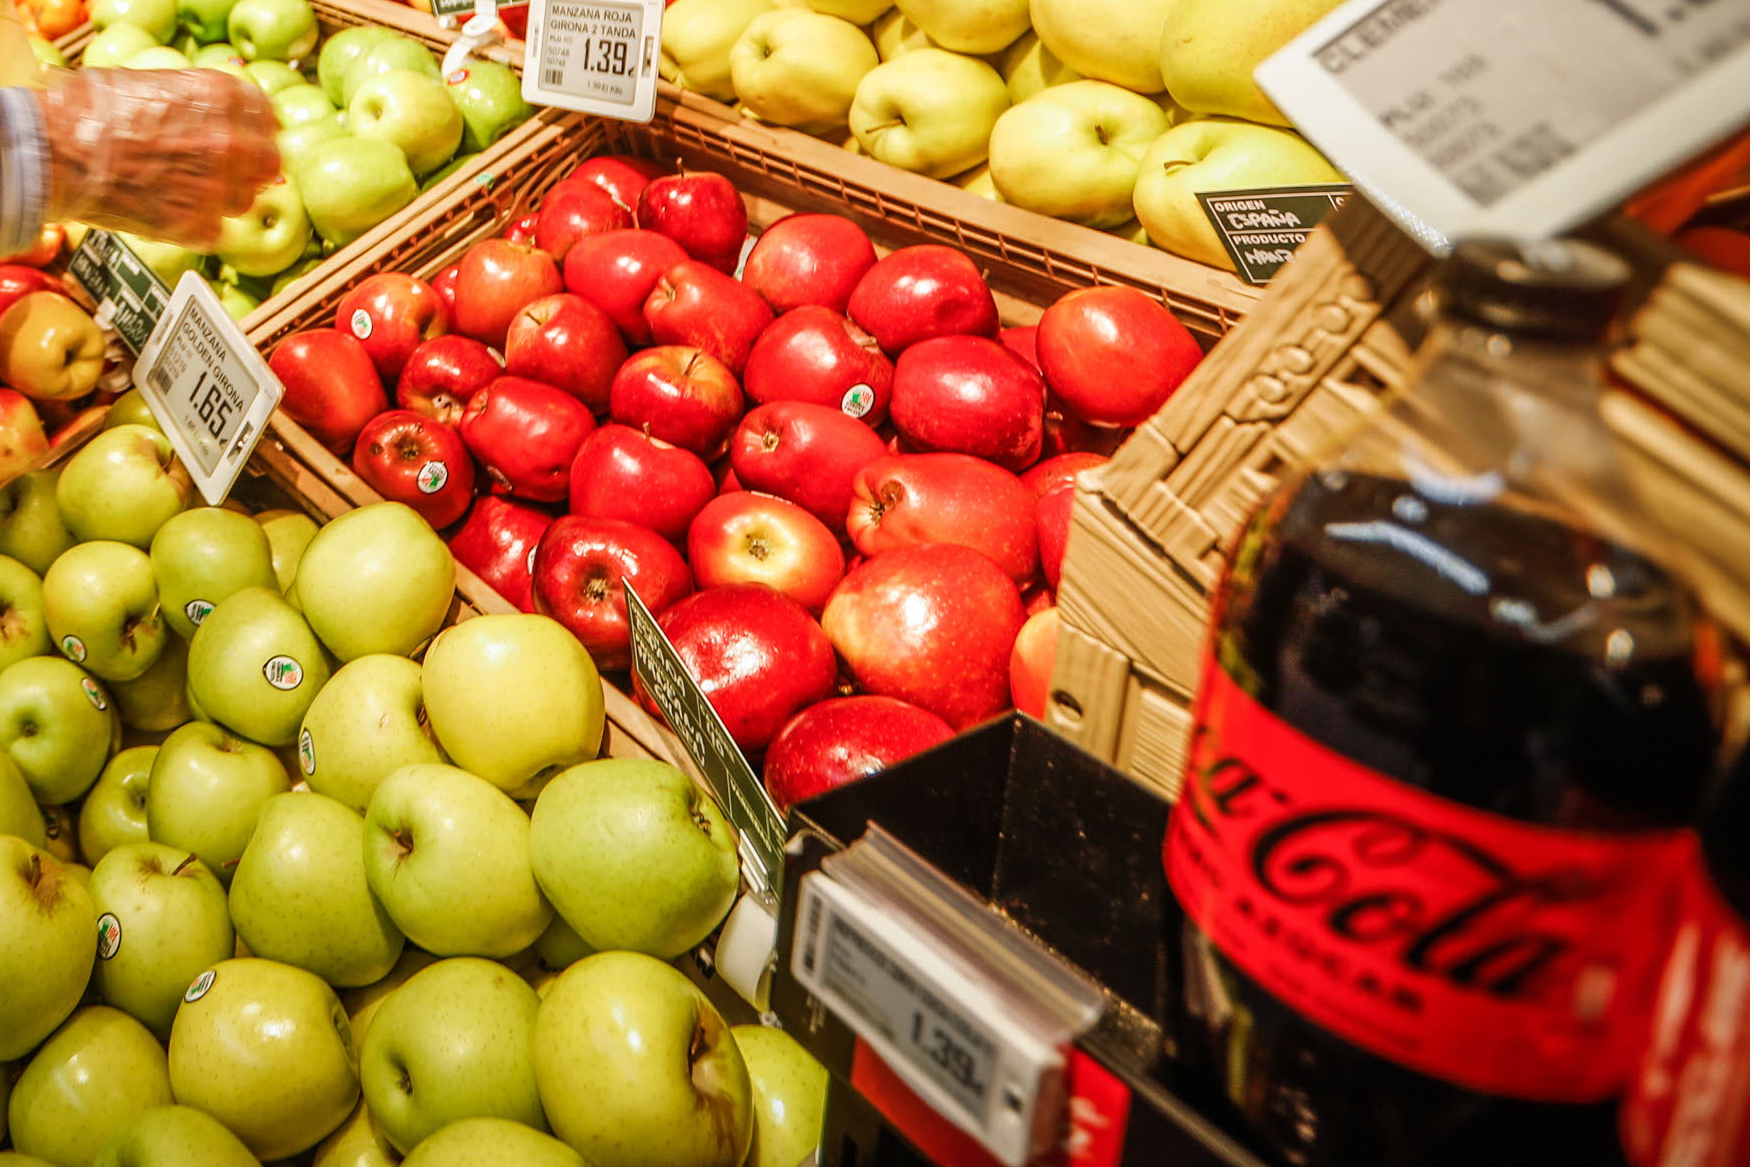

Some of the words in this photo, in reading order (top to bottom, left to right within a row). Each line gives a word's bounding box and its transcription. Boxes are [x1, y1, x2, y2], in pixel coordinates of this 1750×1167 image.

[552, 5, 600, 20] MANZANA
[604, 10, 632, 23] ROJA
[550, 19, 589, 33] GIRONA
[592, 24, 598, 33] 2
[601, 26, 636, 39] TANDA
[1214, 200, 1266, 213] ORIGEN
[1227, 209, 1302, 230] ESPAÑA
[1233, 233, 1306, 246] PRODUCTO
[1244, 247, 1294, 266] MANZ
[188, 308, 227, 363] MANZANA
[181, 324, 214, 369] GOLDEN
[211, 365, 245, 412] GIRONA
